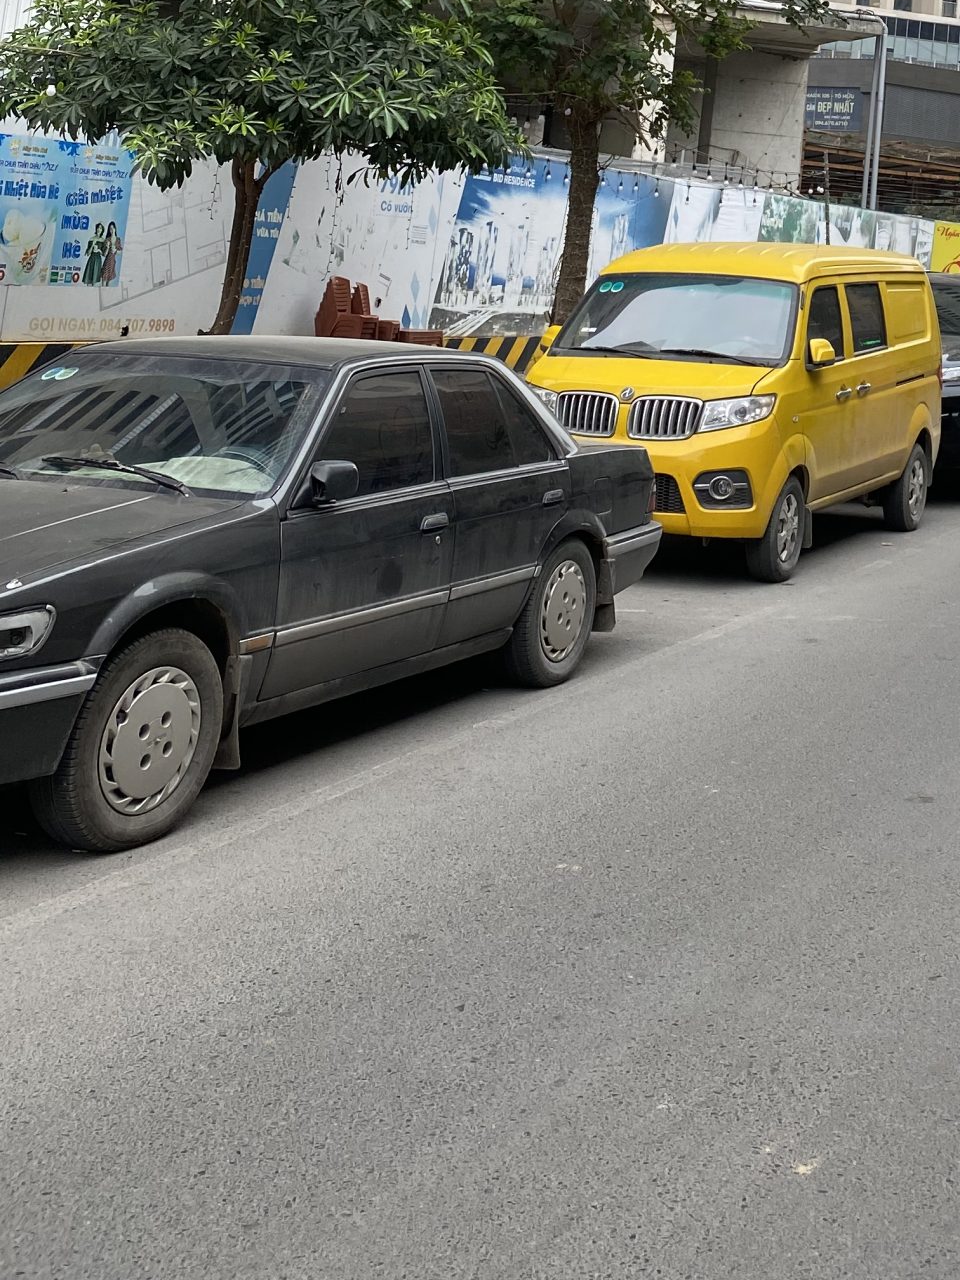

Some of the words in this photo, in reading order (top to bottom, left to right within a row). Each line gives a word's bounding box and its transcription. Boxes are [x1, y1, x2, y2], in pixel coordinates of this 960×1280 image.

[817, 101, 832, 115] ĐẸP
[833, 99, 855, 114] NHẤT
[380, 200, 392, 212] Có
[29, 318, 55, 336] GỌI
[58, 318, 97, 333] NGAY:
[100, 318, 175, 333] 084707.9898
